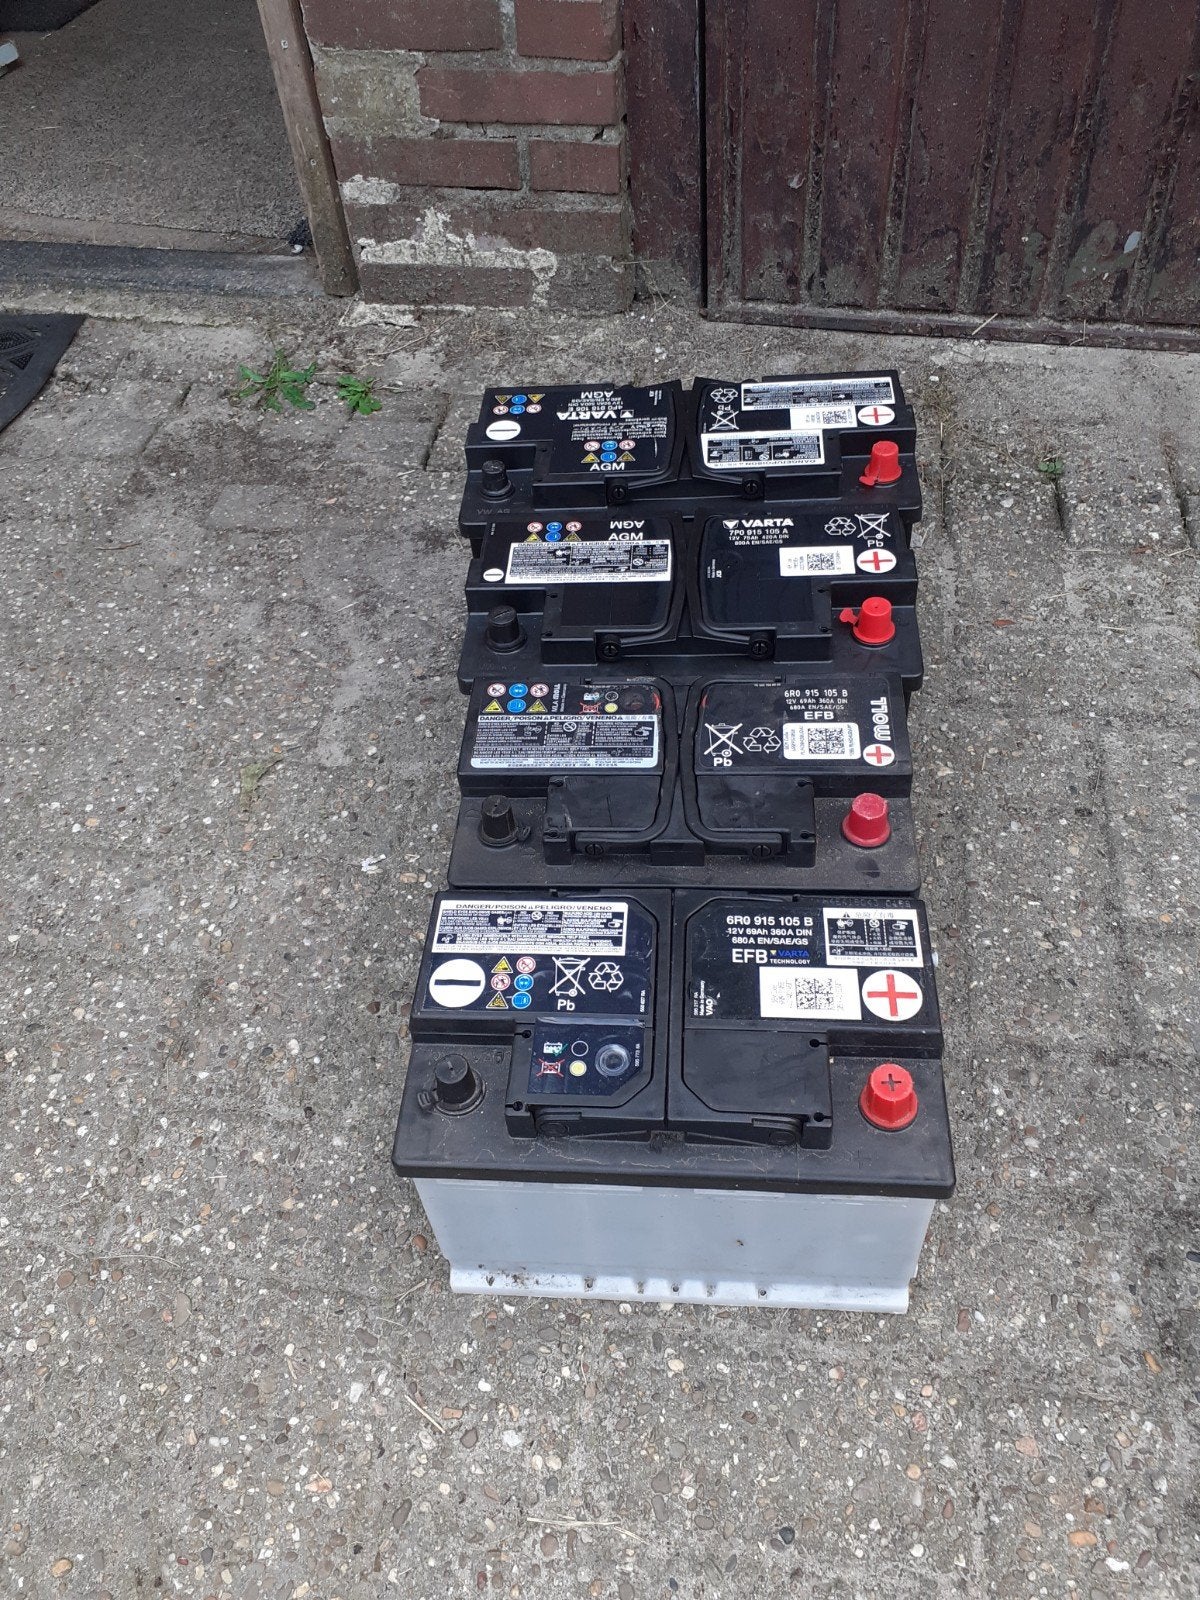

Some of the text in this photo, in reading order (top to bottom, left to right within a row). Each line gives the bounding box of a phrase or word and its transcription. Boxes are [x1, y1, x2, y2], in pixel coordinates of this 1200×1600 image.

[556, 410, 617, 420] VARTA
[590, 462, 625, 471] AGM
[610, 520, 644, 529] AGM
[741, 516, 794, 528] VARTA
[609, 532, 644, 541] AGM
[868, 540, 884, 548] Pb
[784, 688, 848, 698] 6R0 915 105 B
[804, 711, 834, 720] EFB
[714, 757, 732, 766] Pb
[726, 915, 814, 926] 6R0 915 105 B
[746, 928, 768, 936] 69Ah
[796, 928, 812, 936] DIN
[732, 936, 808, 946] 680A EN/SAE/GS
[732, 948, 810, 964] EFB VARTA
[557, 998, 576, 1010] Pb
